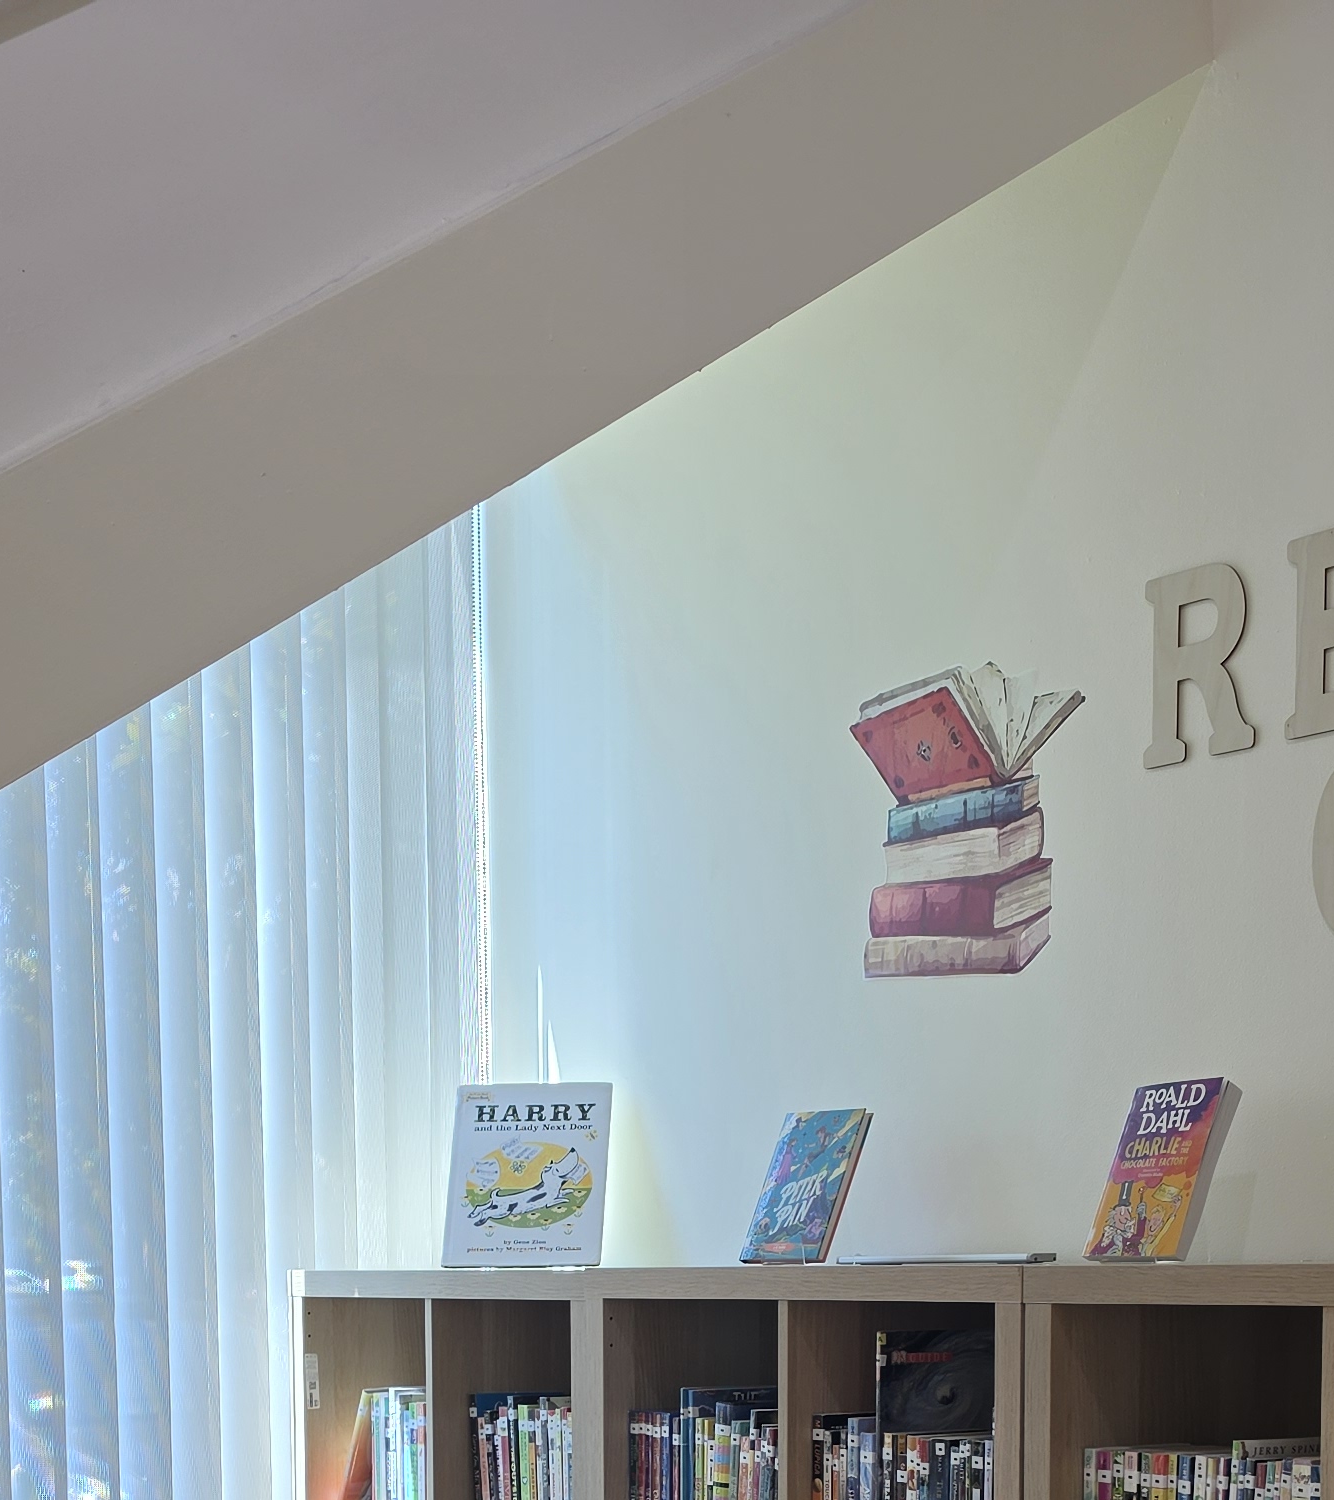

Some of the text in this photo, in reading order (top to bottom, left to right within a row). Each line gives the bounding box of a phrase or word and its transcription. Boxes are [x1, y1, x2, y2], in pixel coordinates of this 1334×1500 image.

[1140, 1084, 1206, 1112] ROALD
[474, 1103, 596, 1123] HARRY
[1137, 1109, 1192, 1135] DAHL
[515, 1124, 539, 1133] Lady
[542, 1123, 566, 1131] Next
[570, 1123, 593, 1131] Door
[1121, 1156, 1189, 1169] CHOCOLATE FACTORY
[769, 1196, 816, 1235] PAN
